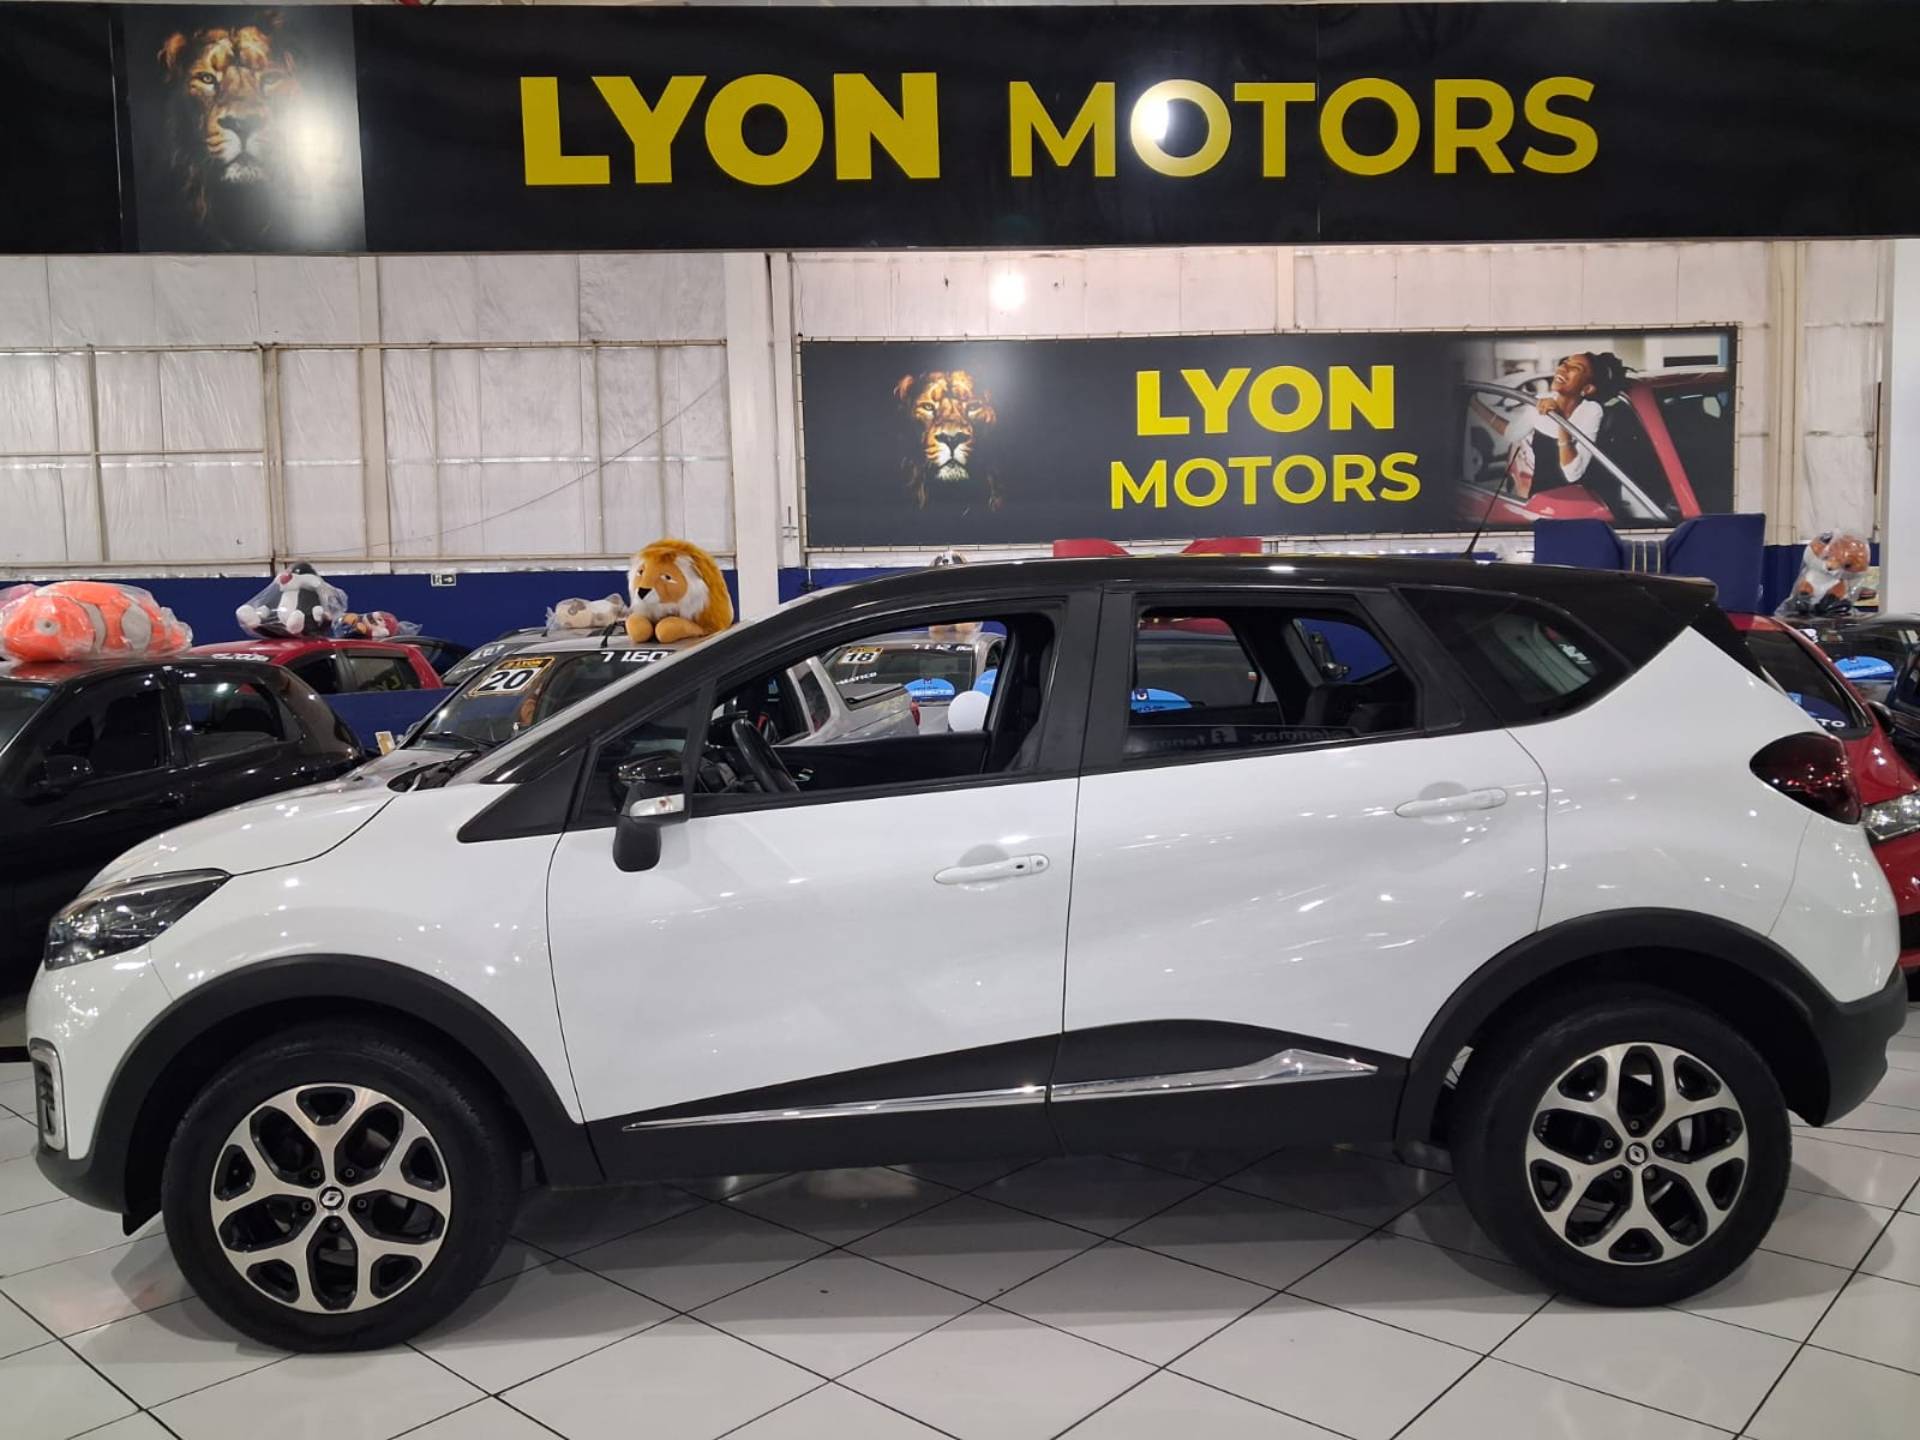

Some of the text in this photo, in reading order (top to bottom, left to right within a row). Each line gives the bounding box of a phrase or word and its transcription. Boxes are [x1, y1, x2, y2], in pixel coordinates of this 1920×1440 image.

[521, 73, 1598, 186] LYON MOTORS
[1136, 364, 1396, 437] LYON
[1110, 452, 1421, 510] MOTORS
[477, 669, 534, 692] 20
[847, 653, 875, 662] 18
